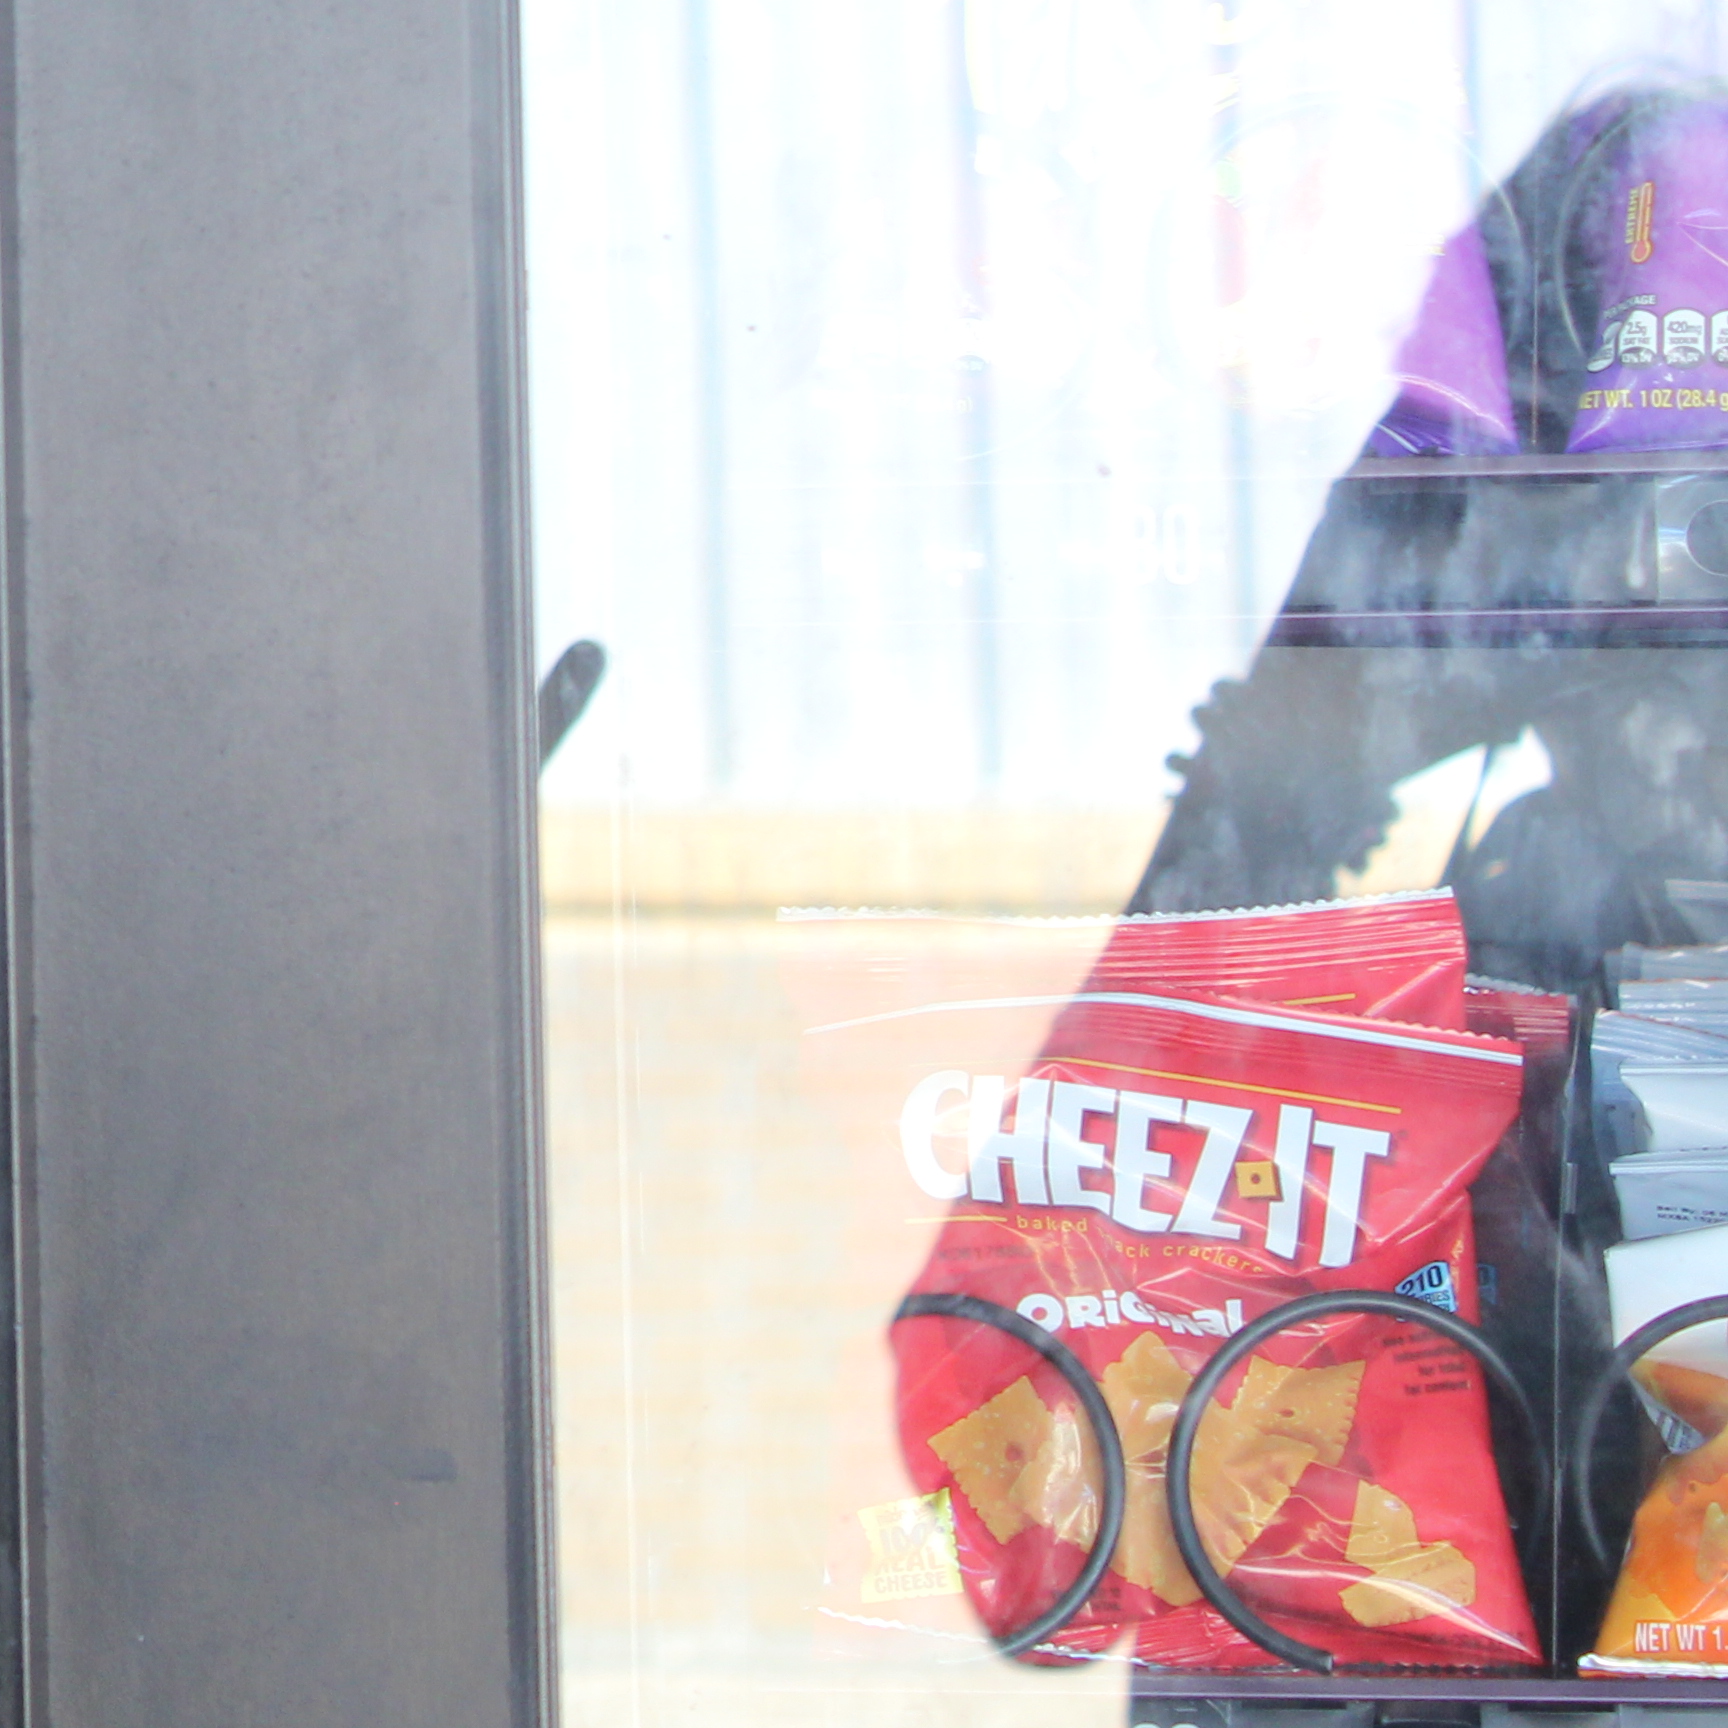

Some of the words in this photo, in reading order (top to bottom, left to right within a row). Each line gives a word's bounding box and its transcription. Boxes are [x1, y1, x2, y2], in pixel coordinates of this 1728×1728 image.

[1625, 187, 1640, 245] EXTREME
[1603, 389, 1635, 410] WT.
[1016, 1214, 1089, 1233] baked
[1401, 1265, 1443, 1296] 210
[1635, 1622, 1671, 1652] NET
[1675, 1623, 1707, 1651] WT
